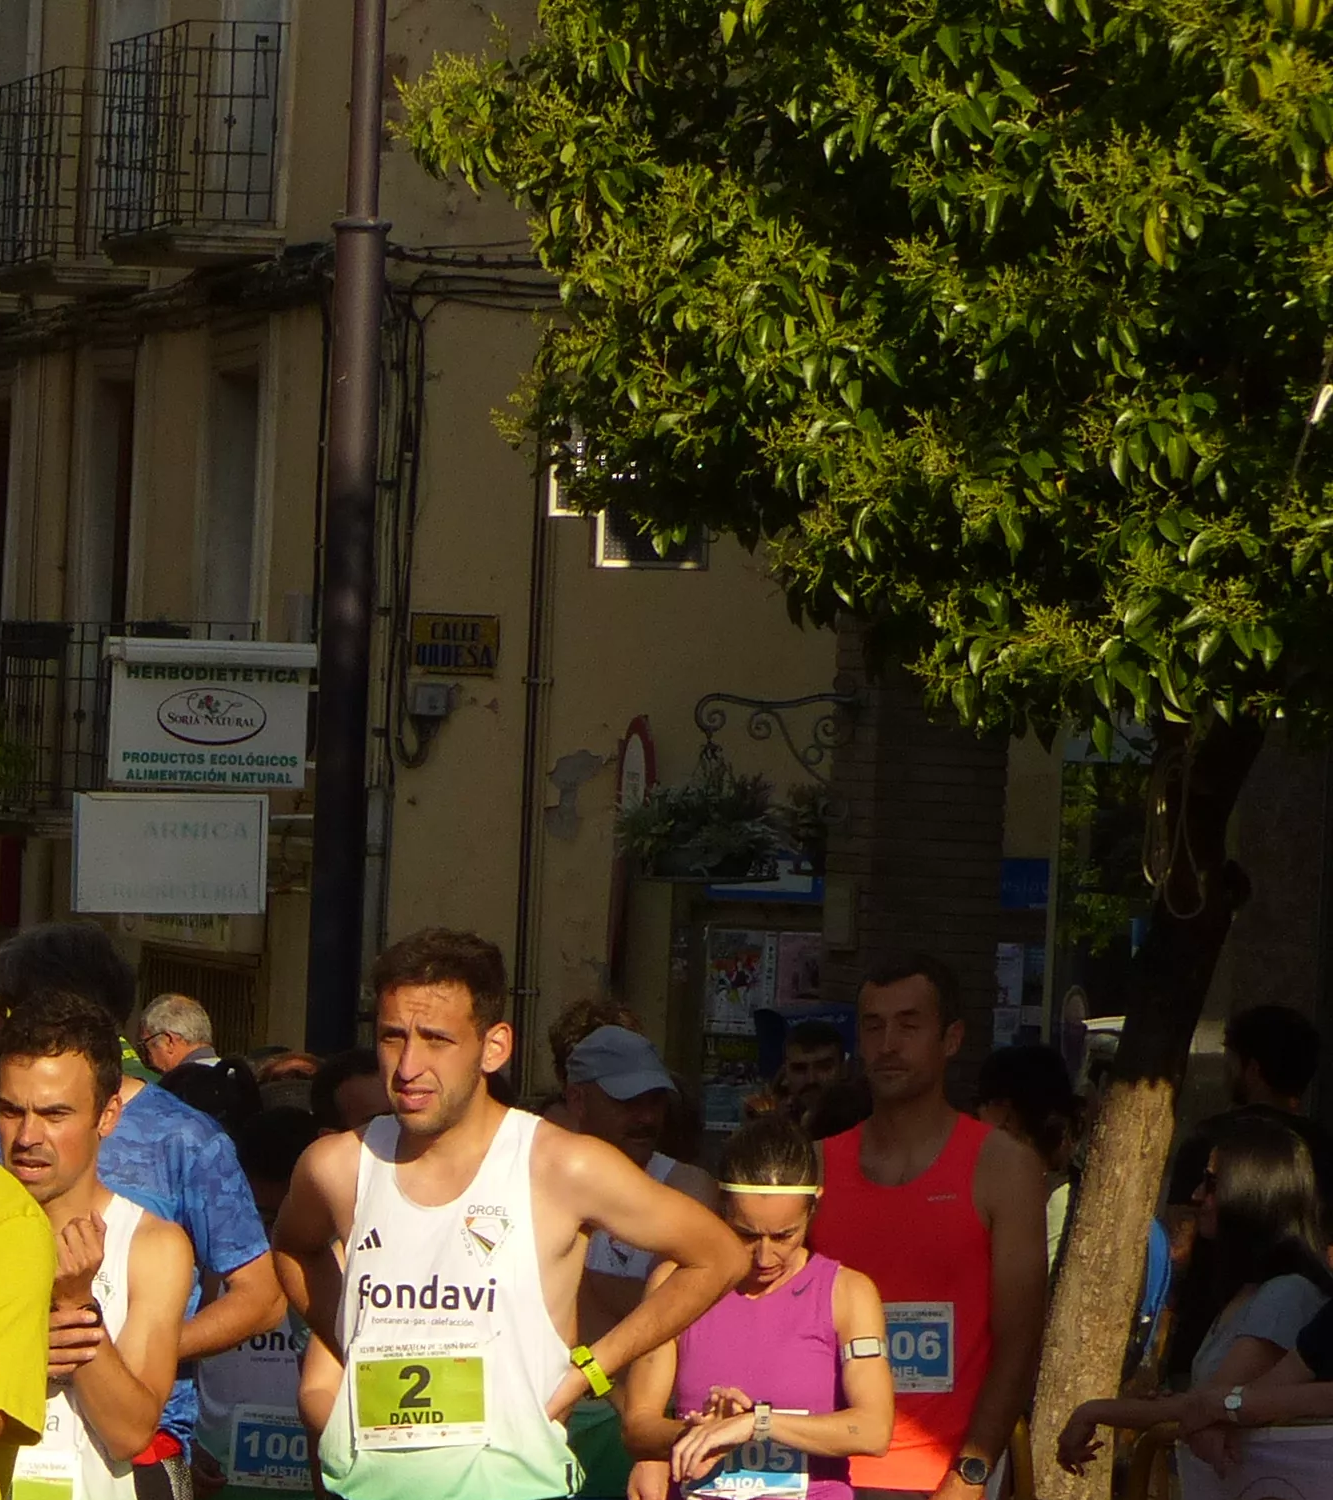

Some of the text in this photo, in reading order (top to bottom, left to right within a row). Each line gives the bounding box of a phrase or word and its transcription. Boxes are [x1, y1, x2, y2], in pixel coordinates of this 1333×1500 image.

[122, 751, 298, 768] PRODUCTOS ECOLÓGICOS
[125, 767, 293, 784] ALIMENTACIÓN NATURAL
[467, 1204, 509, 1217] OROEL
[358, 1274, 497, 1313] fondavi
[398, 1364, 432, 1409] 2
[389, 1410, 444, 1426] DAVID
[714, 1476, 767, 1491] SAIOA
